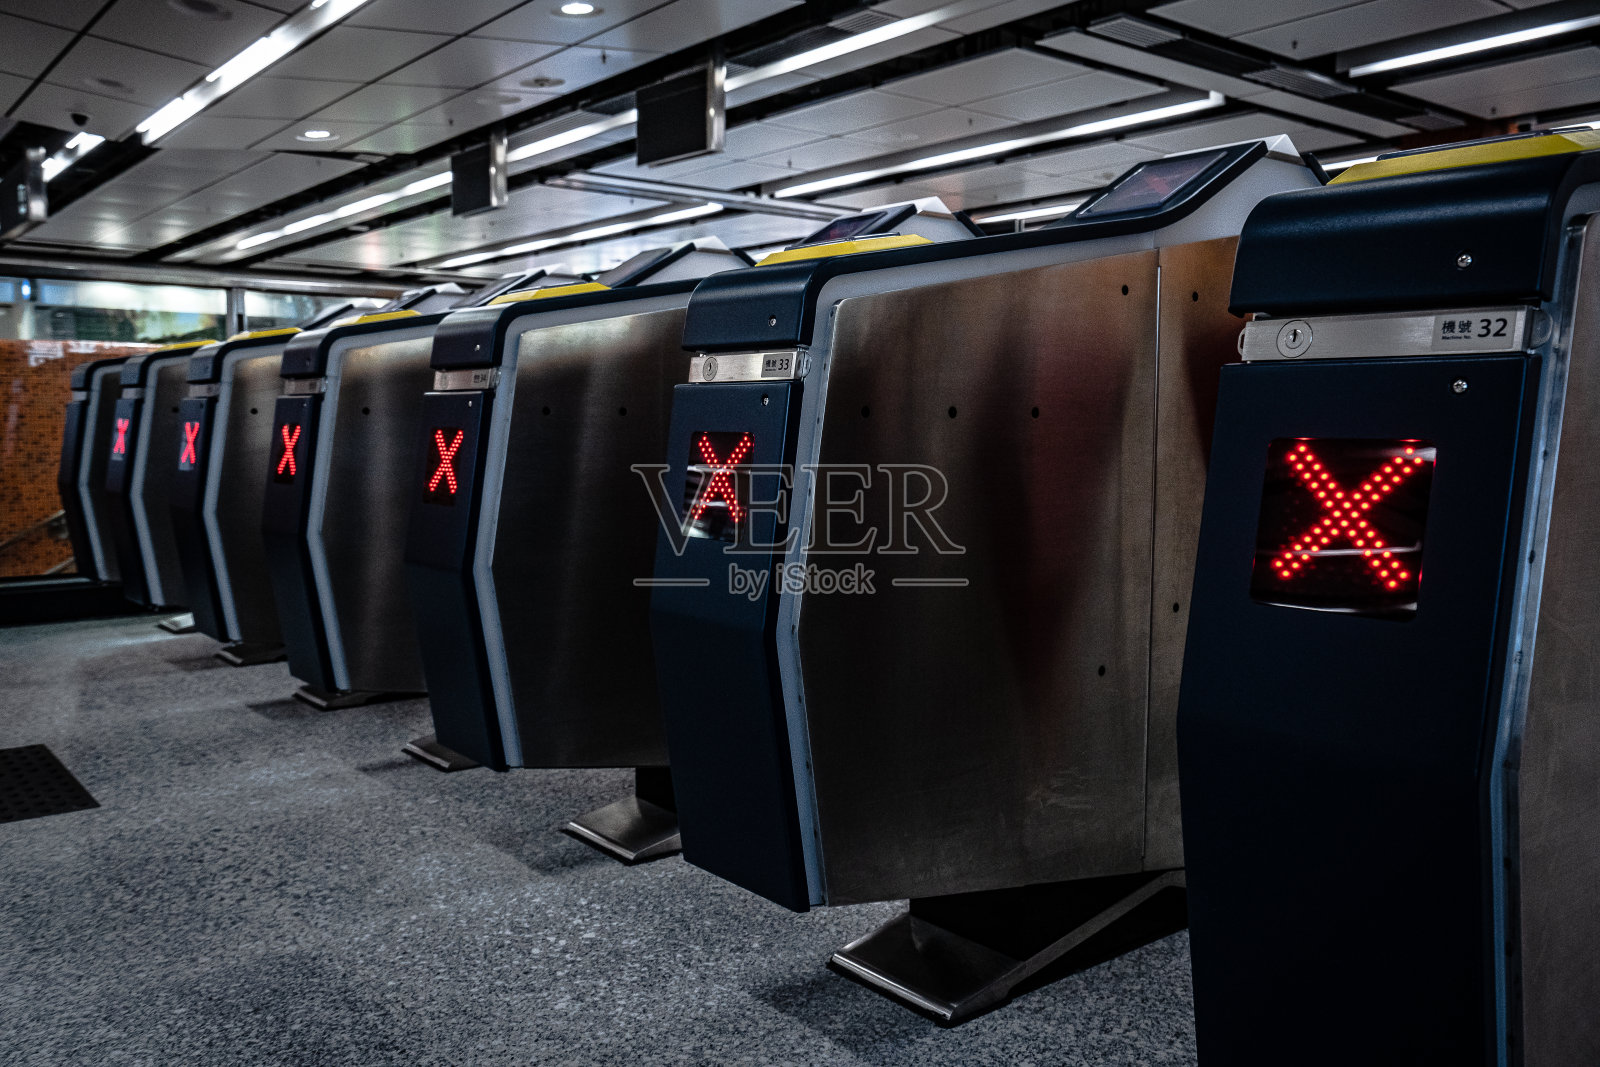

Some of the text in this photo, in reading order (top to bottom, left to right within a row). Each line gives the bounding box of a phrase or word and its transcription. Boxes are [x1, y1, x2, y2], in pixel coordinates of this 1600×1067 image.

[1441, 318, 1508, 338] 機號 32
[777, 358, 789, 370] 33
